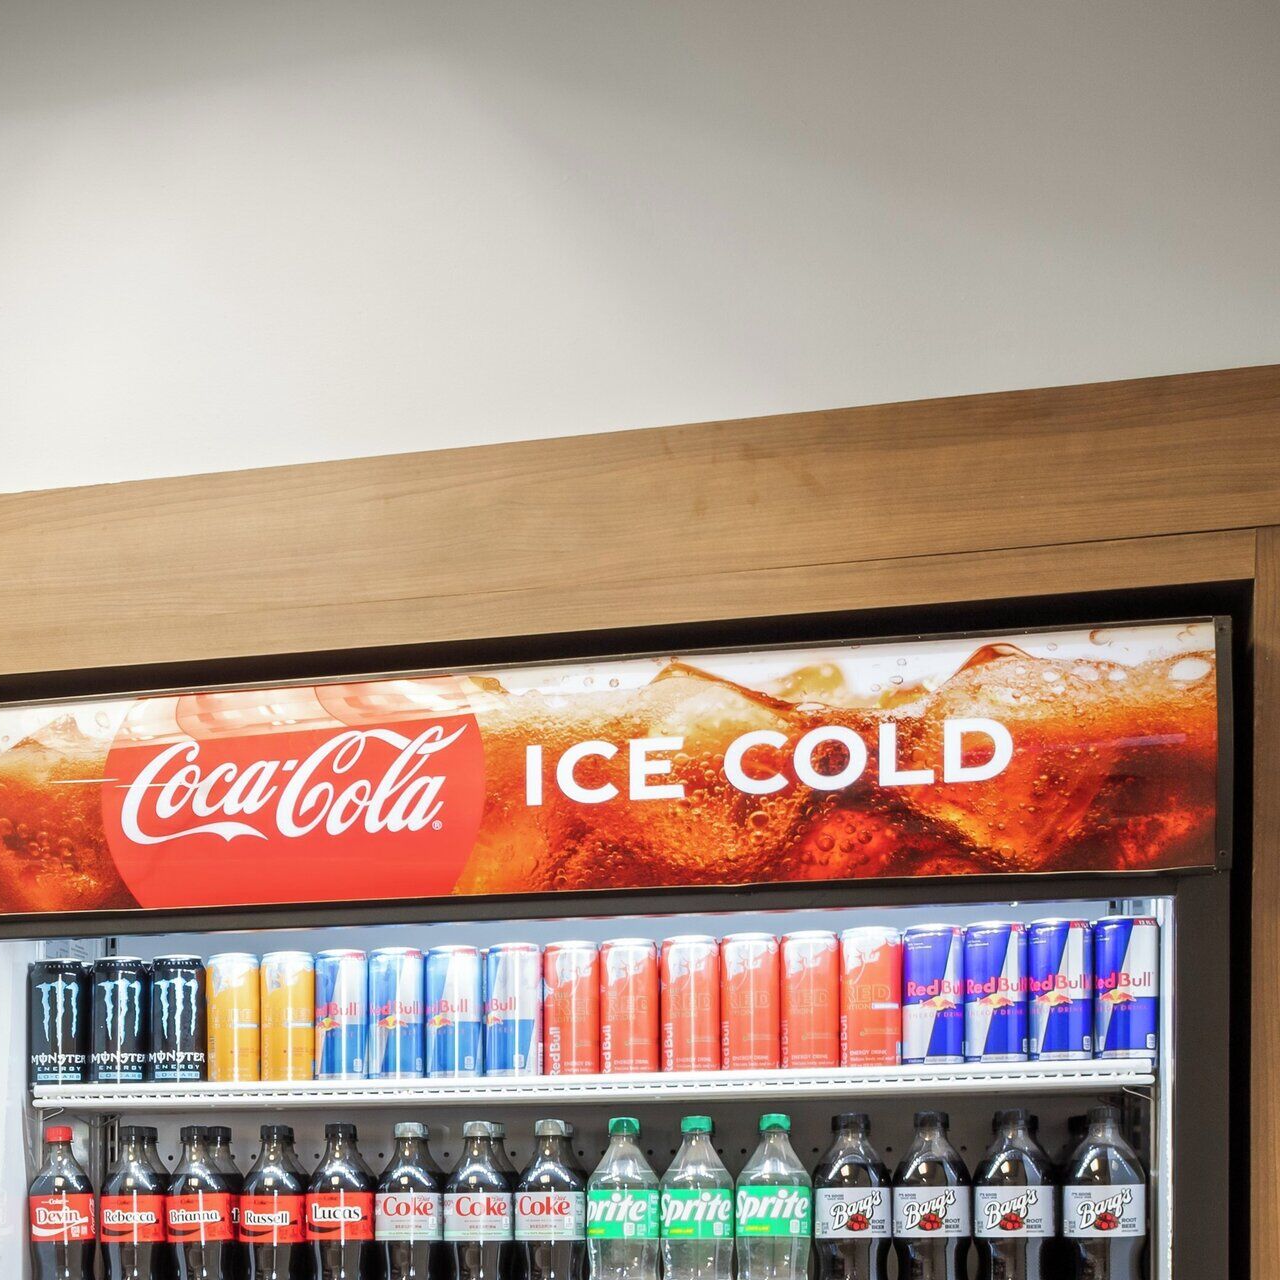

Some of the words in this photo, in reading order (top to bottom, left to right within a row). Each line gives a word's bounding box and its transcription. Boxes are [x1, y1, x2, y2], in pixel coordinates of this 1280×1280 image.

[526, 737, 686, 807] ICE
[724, 717, 1014, 796] COLD
[121, 724, 468, 845] Coca-Cola
[967, 977, 996, 994] Red
[1119, 971, 1151, 987] Bull
[36, 1208, 79, 1223] Devin
[104, 1210, 155, 1222] Rebecca
[169, 1209, 219, 1223] Brianna
[312, 1203, 361, 1221] Lucas
[383, 1197, 433, 1217] Coke
[455, 1197, 507, 1217] Coke
[735, 1189, 808, 1226] Sprite
[1077, 1188, 1132, 1231] Barq's
[245, 1212, 289, 1225] Russell
